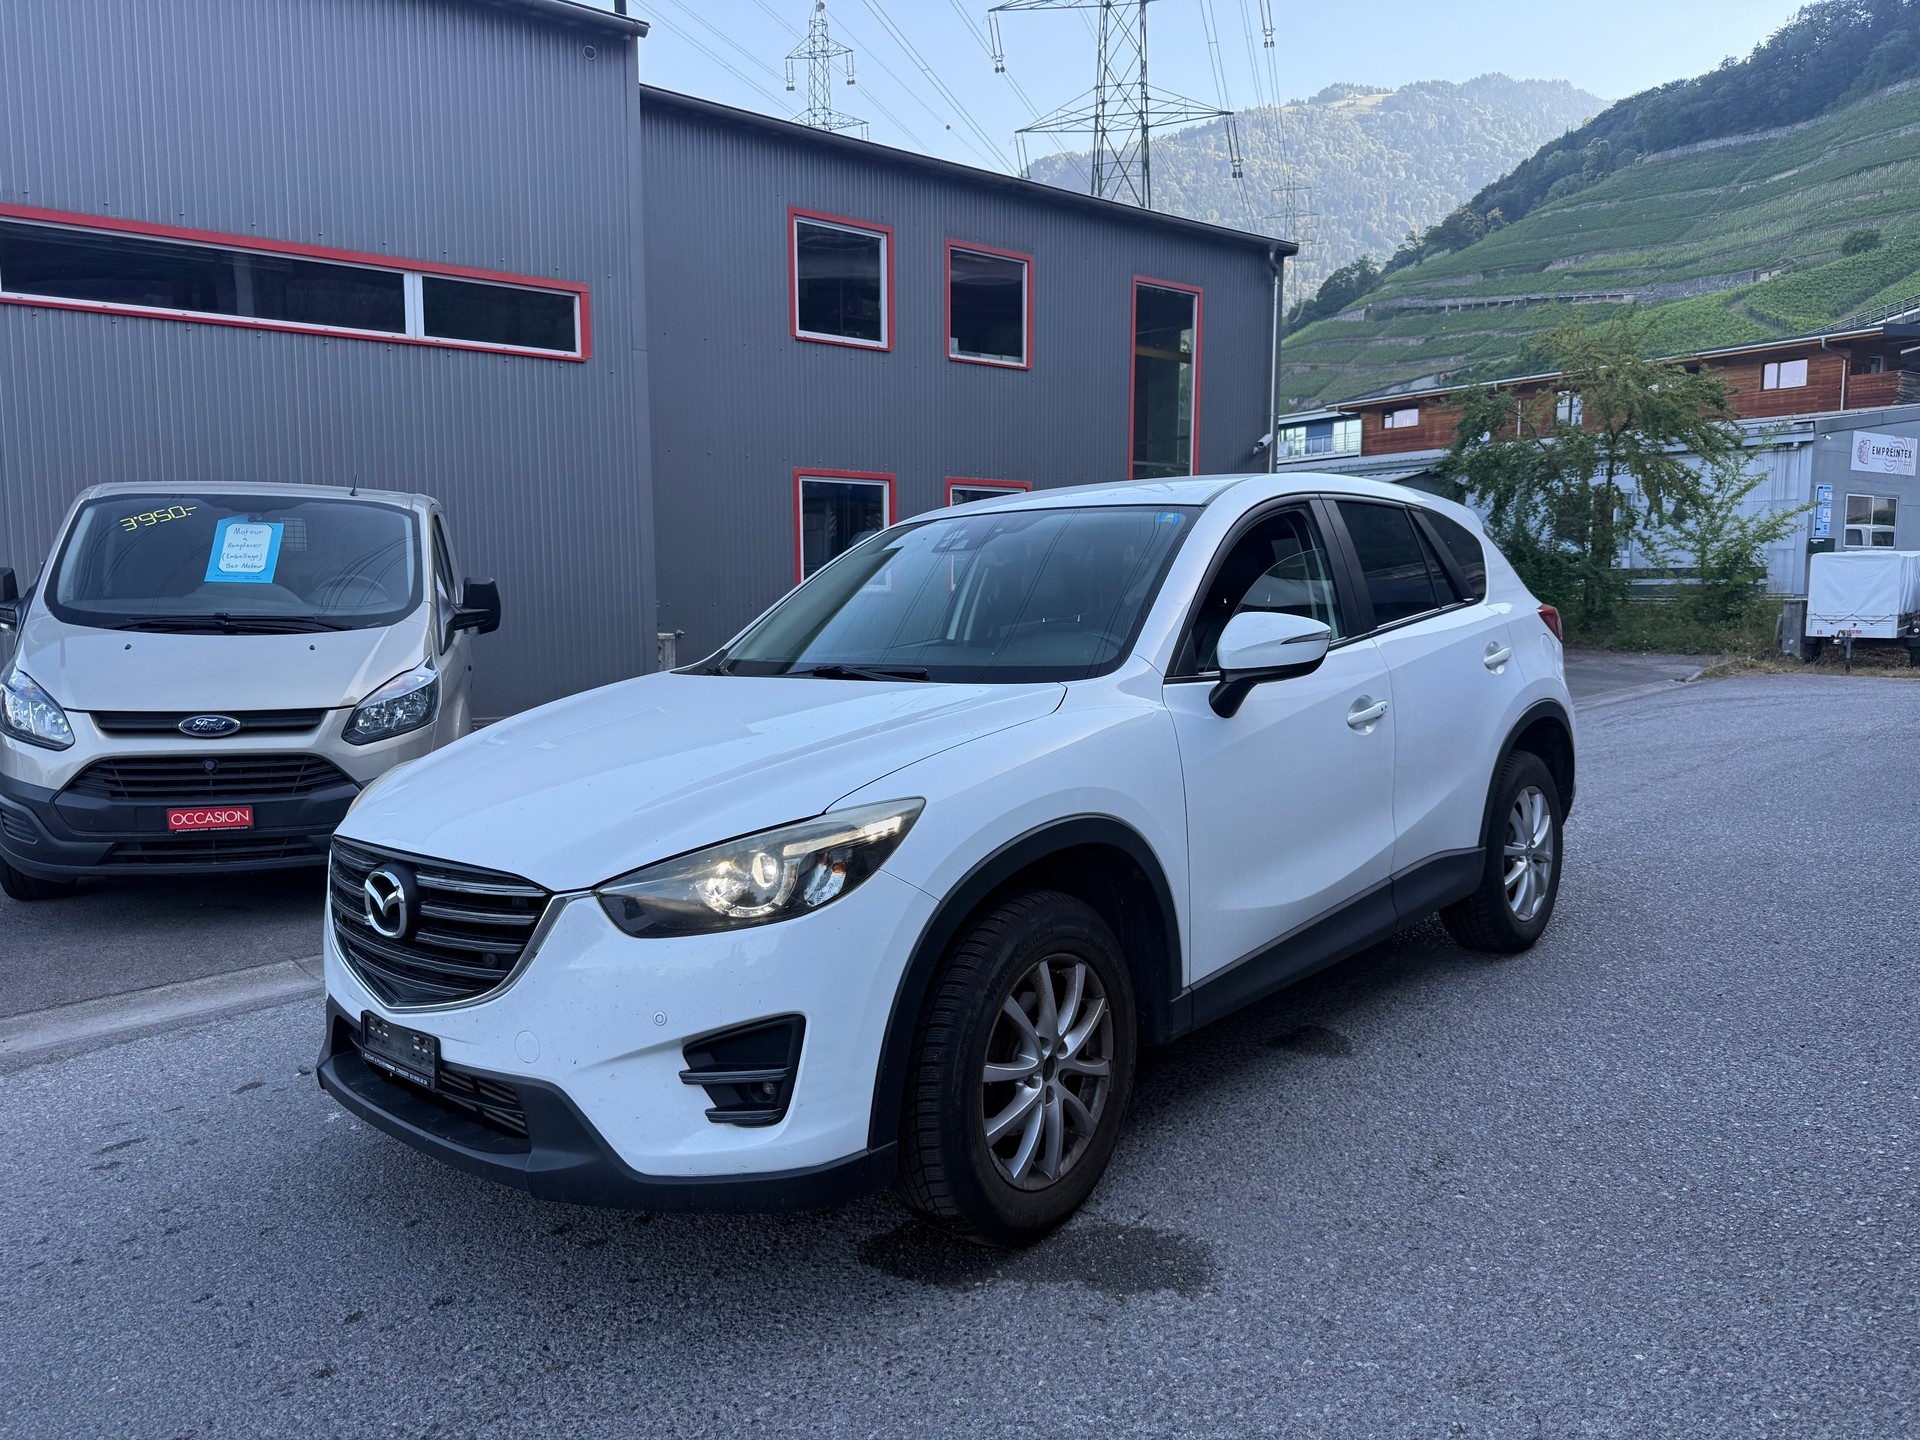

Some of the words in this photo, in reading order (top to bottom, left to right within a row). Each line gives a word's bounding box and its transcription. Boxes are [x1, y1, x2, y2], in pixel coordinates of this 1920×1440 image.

[1872, 446, 1912, 459] EMPREINTEX
[233, 527, 264, 535] Moteur
[227, 542, 263, 551] Remplacer
[192, 718, 226, 731] Ford
[171, 810, 249, 826] OCCASION
